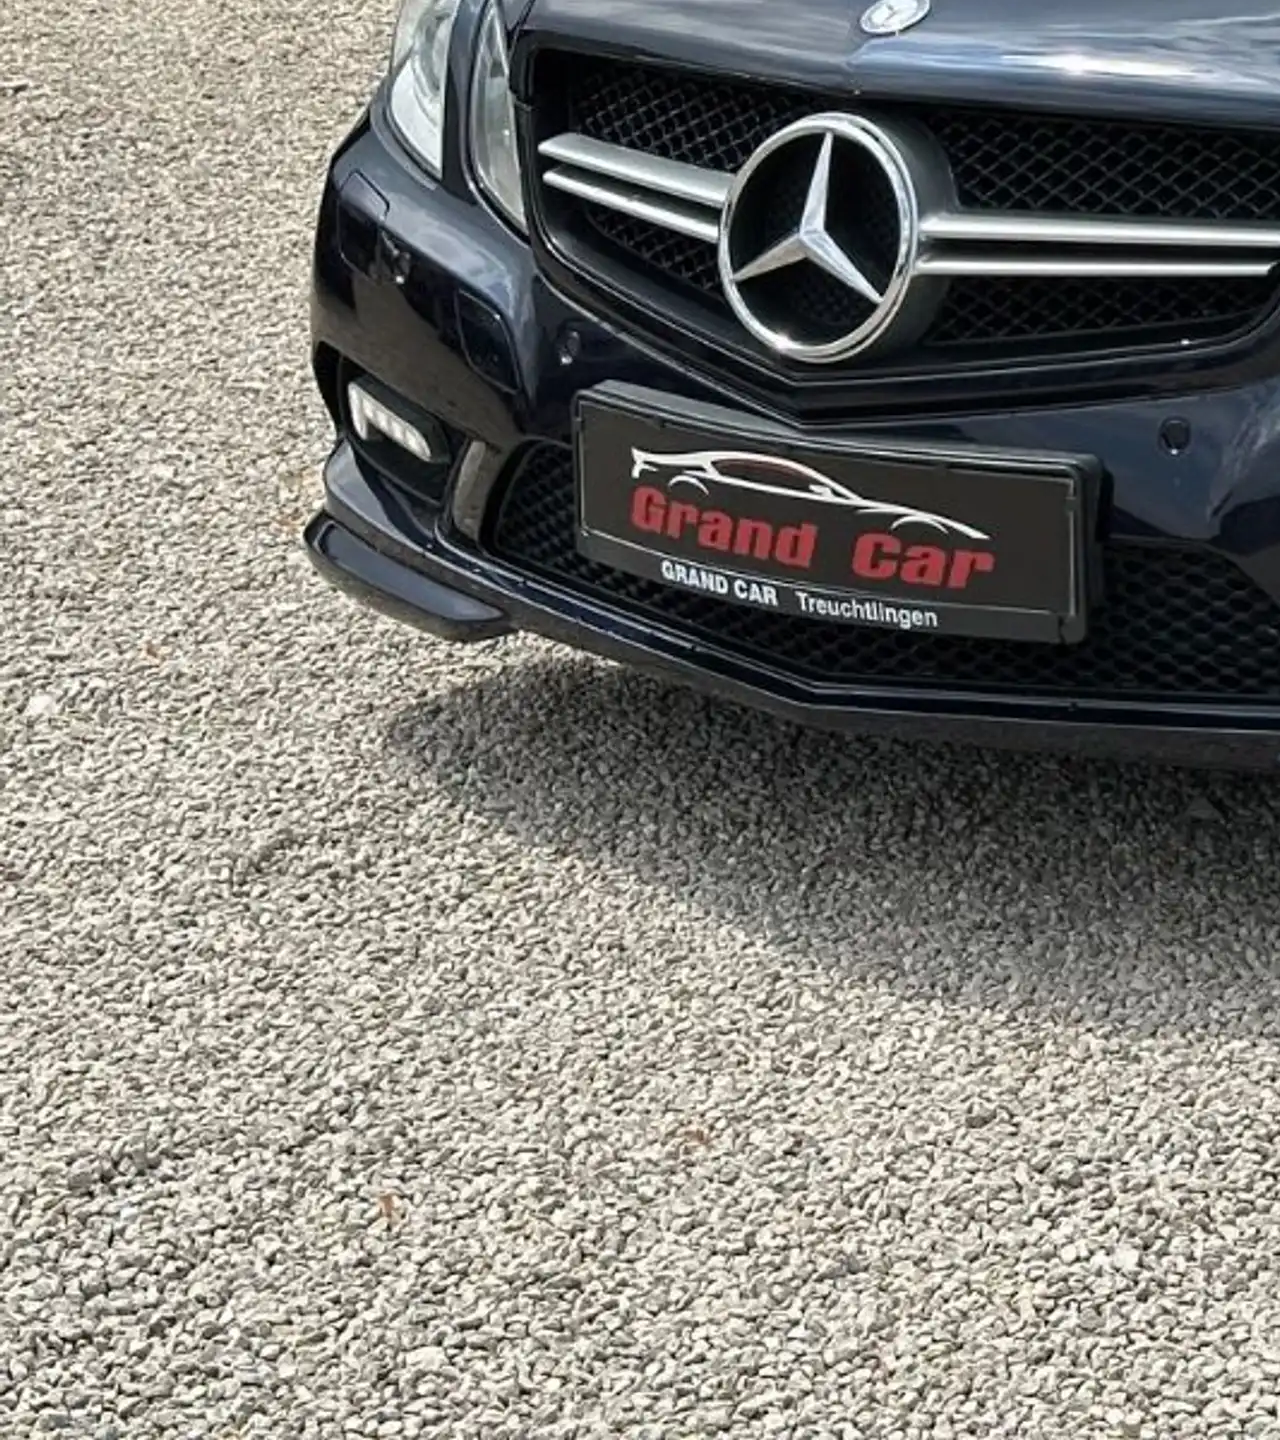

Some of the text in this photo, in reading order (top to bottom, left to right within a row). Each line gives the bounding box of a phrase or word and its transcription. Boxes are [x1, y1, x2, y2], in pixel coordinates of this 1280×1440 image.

[631, 485, 995, 589] Grand Car
[660, 560, 938, 630] GRAND CAR Treuchtlingen
